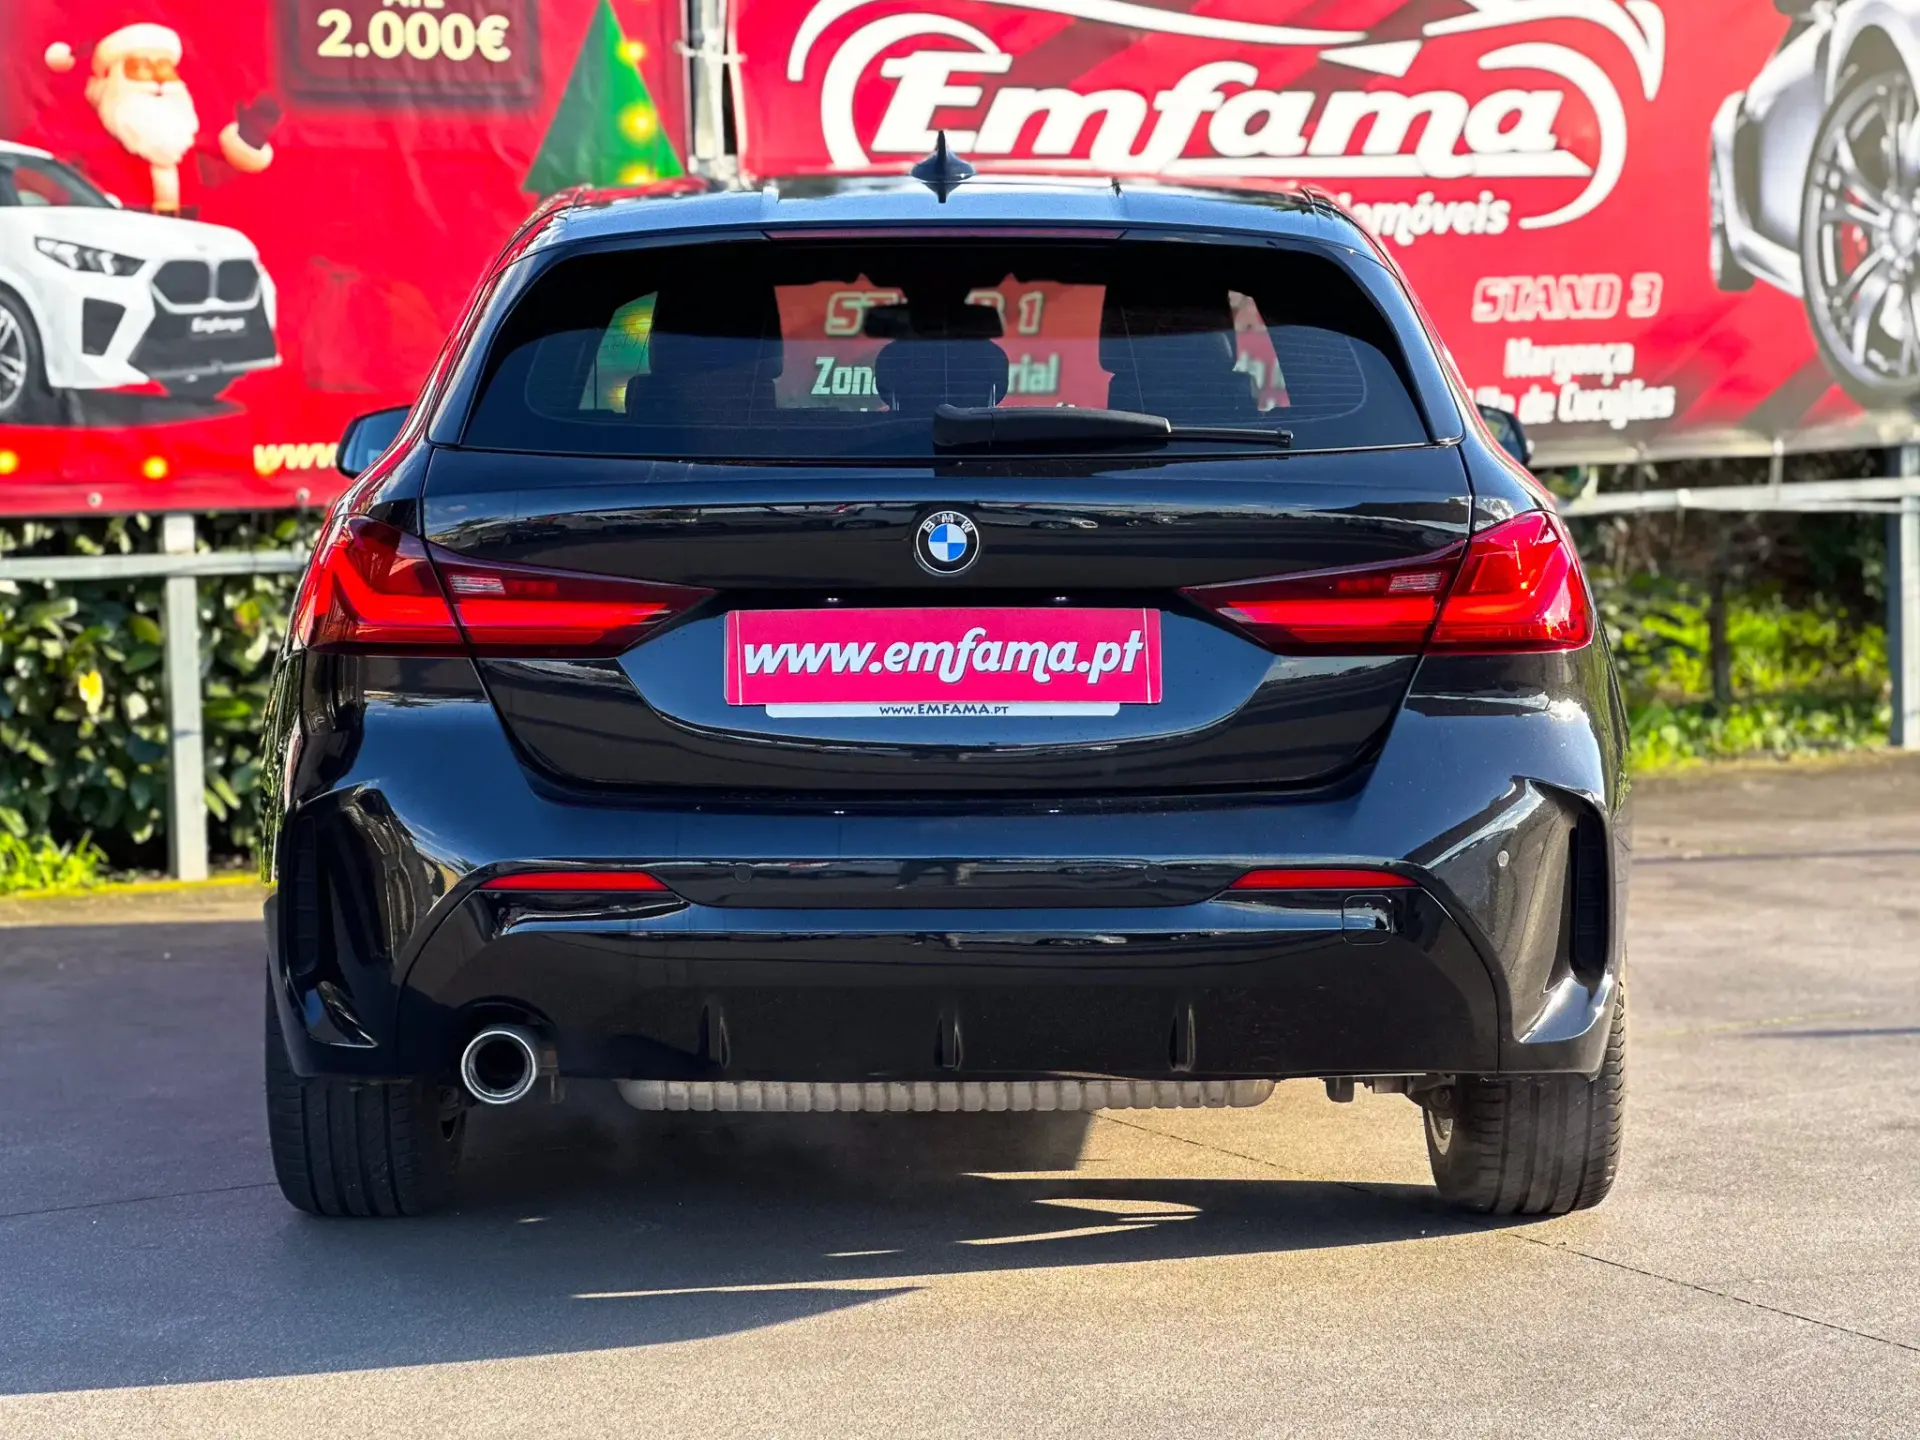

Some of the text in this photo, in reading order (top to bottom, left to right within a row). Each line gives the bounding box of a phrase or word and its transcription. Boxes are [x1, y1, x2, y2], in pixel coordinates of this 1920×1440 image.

[317, 8, 511, 62] 2.000€
[870, 49, 1564, 178] Emfama
[1338, 190, 1511, 246] omóveis
[1471, 272, 1663, 323] STAND 3
[811, 356, 879, 395] Zon
[1008, 353, 1060, 394] rial
[922, 513, 974, 533] BMW
[744, 627, 1145, 685] www.emfama.pt
